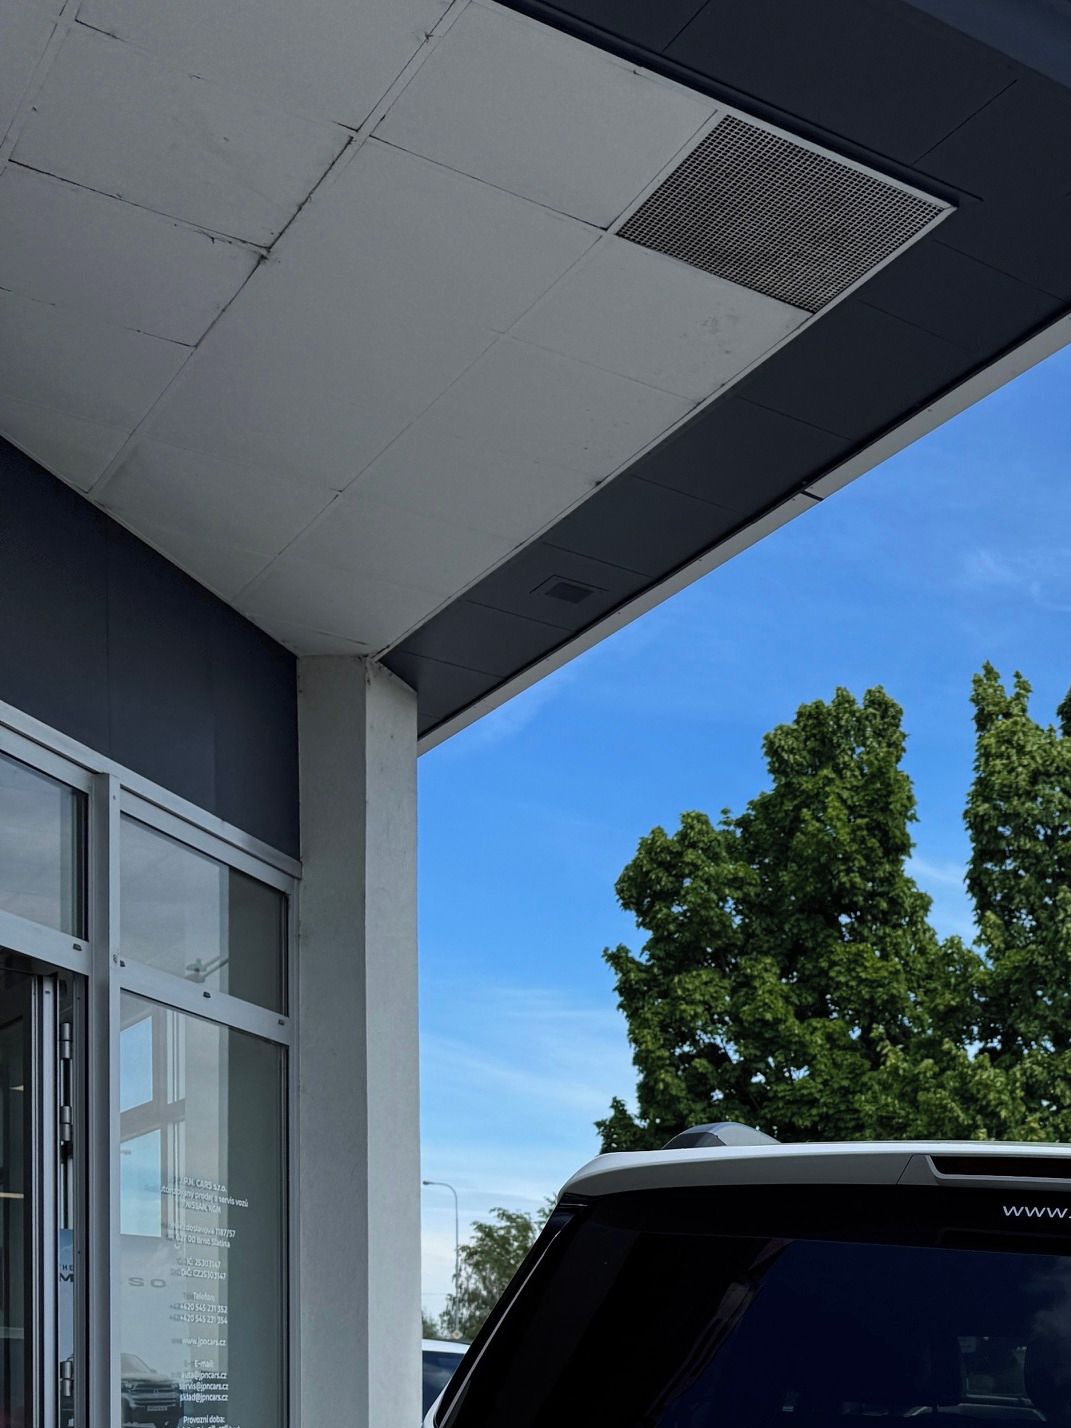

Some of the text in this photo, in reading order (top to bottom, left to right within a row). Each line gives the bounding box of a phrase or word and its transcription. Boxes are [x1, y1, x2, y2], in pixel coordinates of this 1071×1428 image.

[196, 1179, 213, 1191] CARS
[213, 1183, 227, 1193] s.r.o.
[219, 1196, 235, 1206] servis
[235, 1199, 249, 1208] vozů
[179, 1303, 228, 1314] +420 545 231 352
[179, 1314, 228, 1324] +420 545 231 354
[182, 1338, 227, 1347] www.jpncars.cz
[180, 1382, 229, 1392] servis@jpncars.cz
[180, 1393, 229, 1403] sklad@jpncars.cz
[183, 1414, 226, 1424] Provozní doba:
